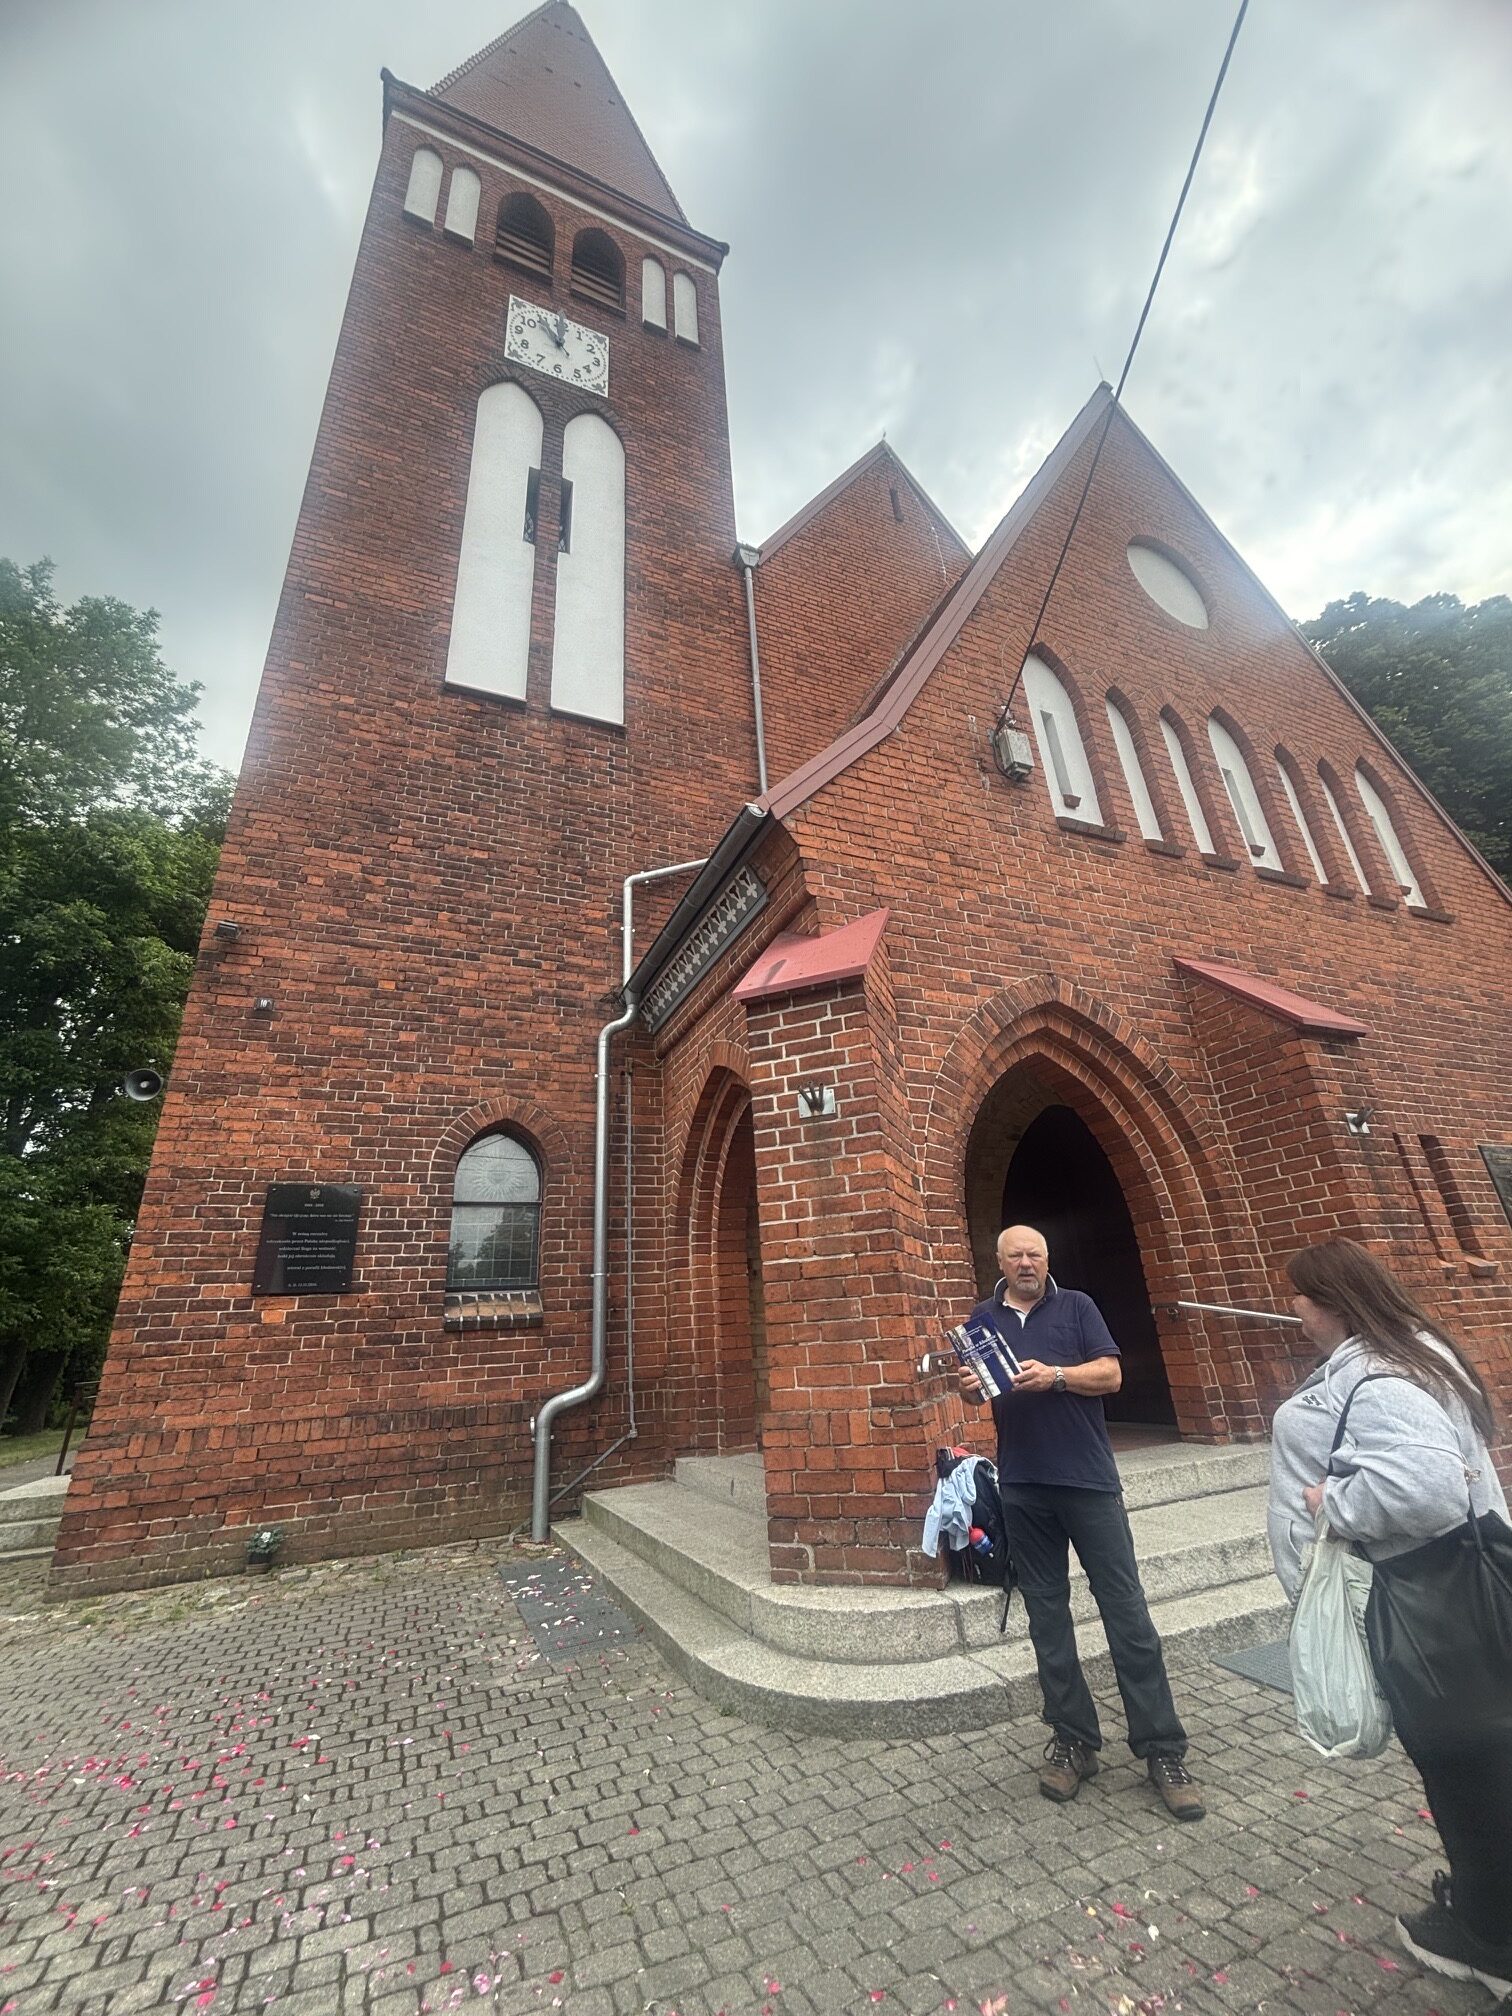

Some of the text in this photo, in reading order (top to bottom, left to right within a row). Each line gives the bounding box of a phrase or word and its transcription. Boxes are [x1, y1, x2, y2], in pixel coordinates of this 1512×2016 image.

[520, 315, 537, 329] 10
[514, 325, 524, 334] 9
[576, 330, 583, 341] 1
[520, 339, 529, 349] 8
[586, 344, 596, 354] 2
[536, 354, 546, 364] 7
[592, 358, 600, 367] 3
[553, 364, 562, 374] 6
[573, 369, 582, 379] 5
[583, 365, 592, 374] 4
